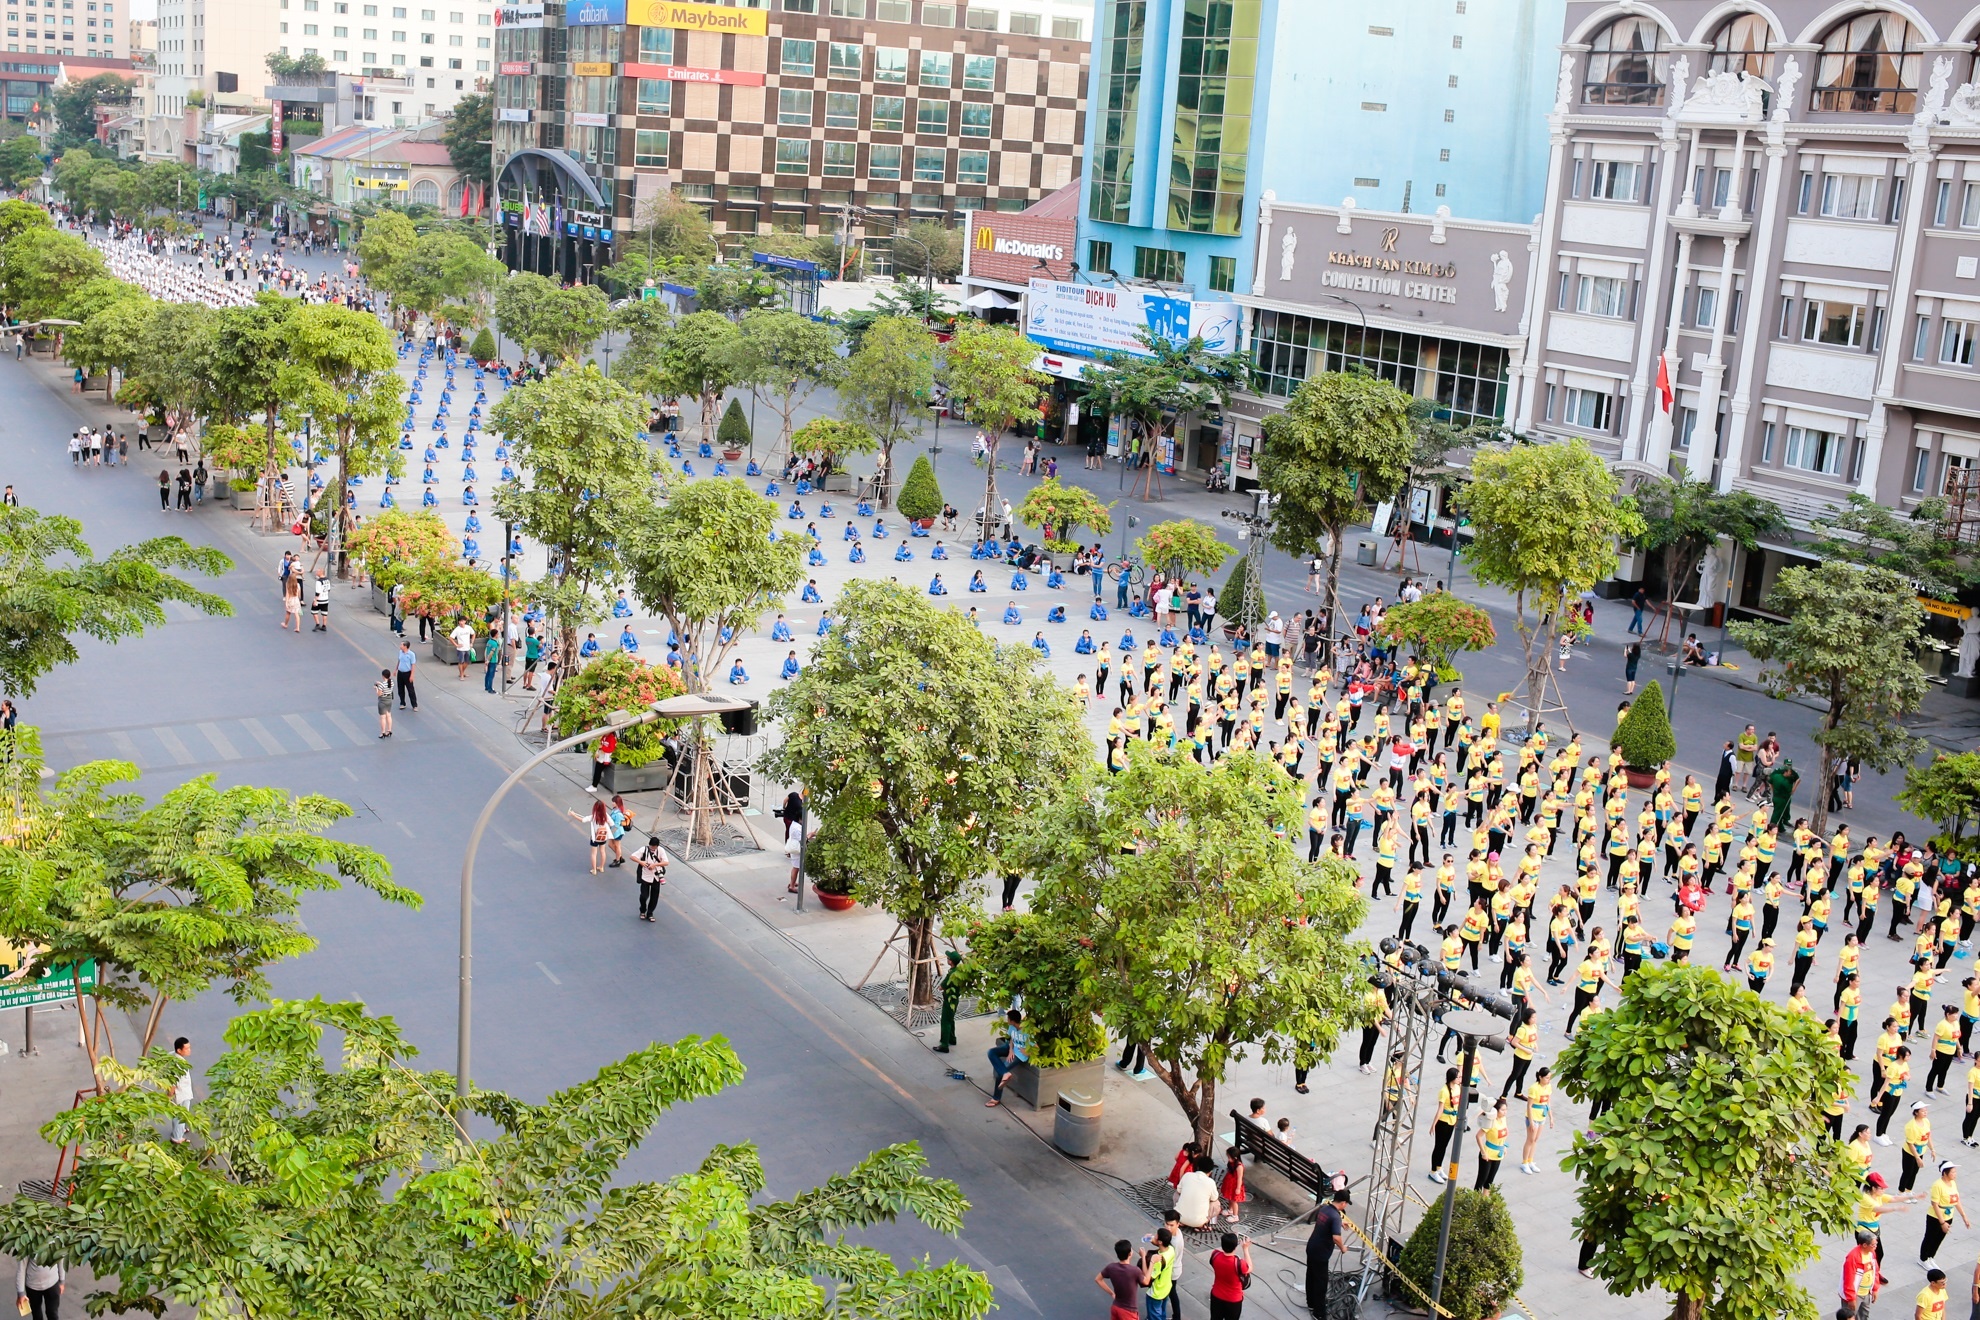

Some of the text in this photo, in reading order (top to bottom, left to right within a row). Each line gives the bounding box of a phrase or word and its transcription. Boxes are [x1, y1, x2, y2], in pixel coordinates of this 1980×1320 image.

[579, 3, 609, 23] citibank
[671, 8, 748, 29] Maybank
[667, 68, 710, 81] Emirates
[994, 237, 1064, 261] McDonald's
[1404, 260, 1433, 276] KIM
[1056, 285, 1085, 296] FIDITOUR
[1321, 269, 1457, 305] CONVENTION CENTER
[1086, 289, 1104, 308] DỊCH
